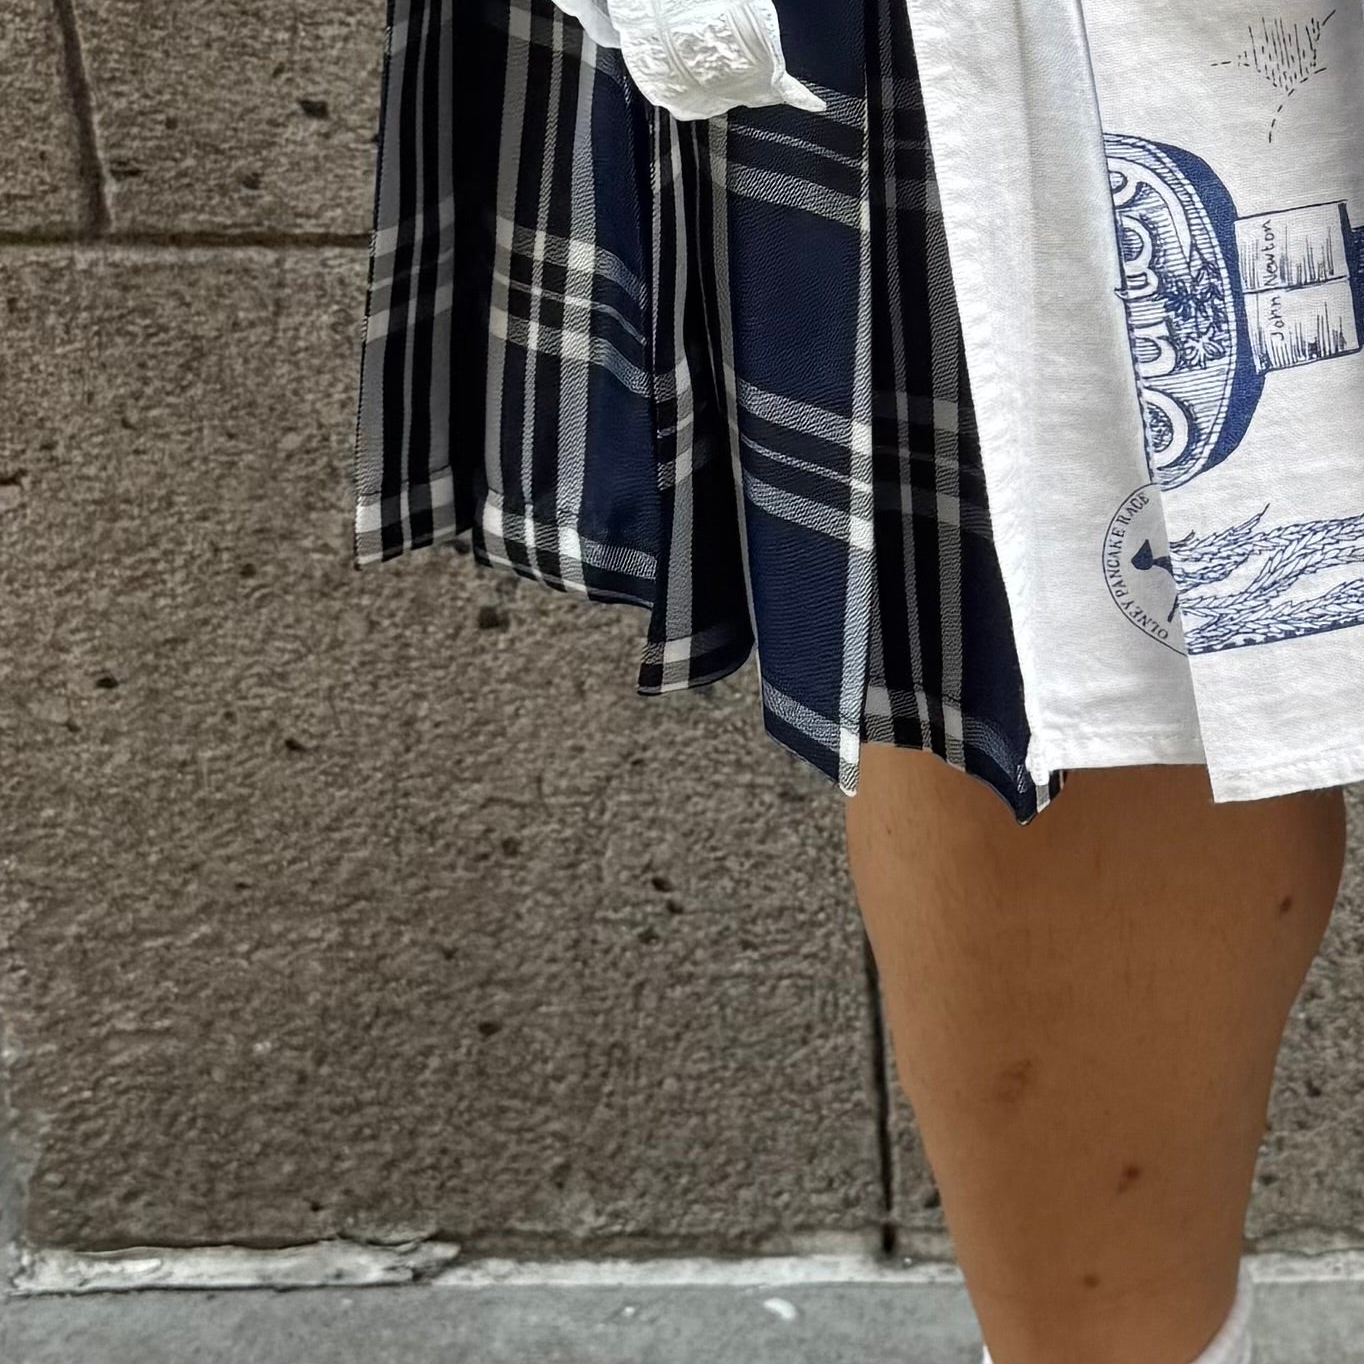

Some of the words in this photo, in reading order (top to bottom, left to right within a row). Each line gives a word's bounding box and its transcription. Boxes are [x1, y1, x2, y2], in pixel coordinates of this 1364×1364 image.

[1259, 219, 1280, 288] Newton
[1267, 293, 1287, 342] John
[1118, 490, 1151, 534] RACE
[1112, 536, 1129, 598] PANCAKE
[1126, 590, 1169, 642] OLNEY
